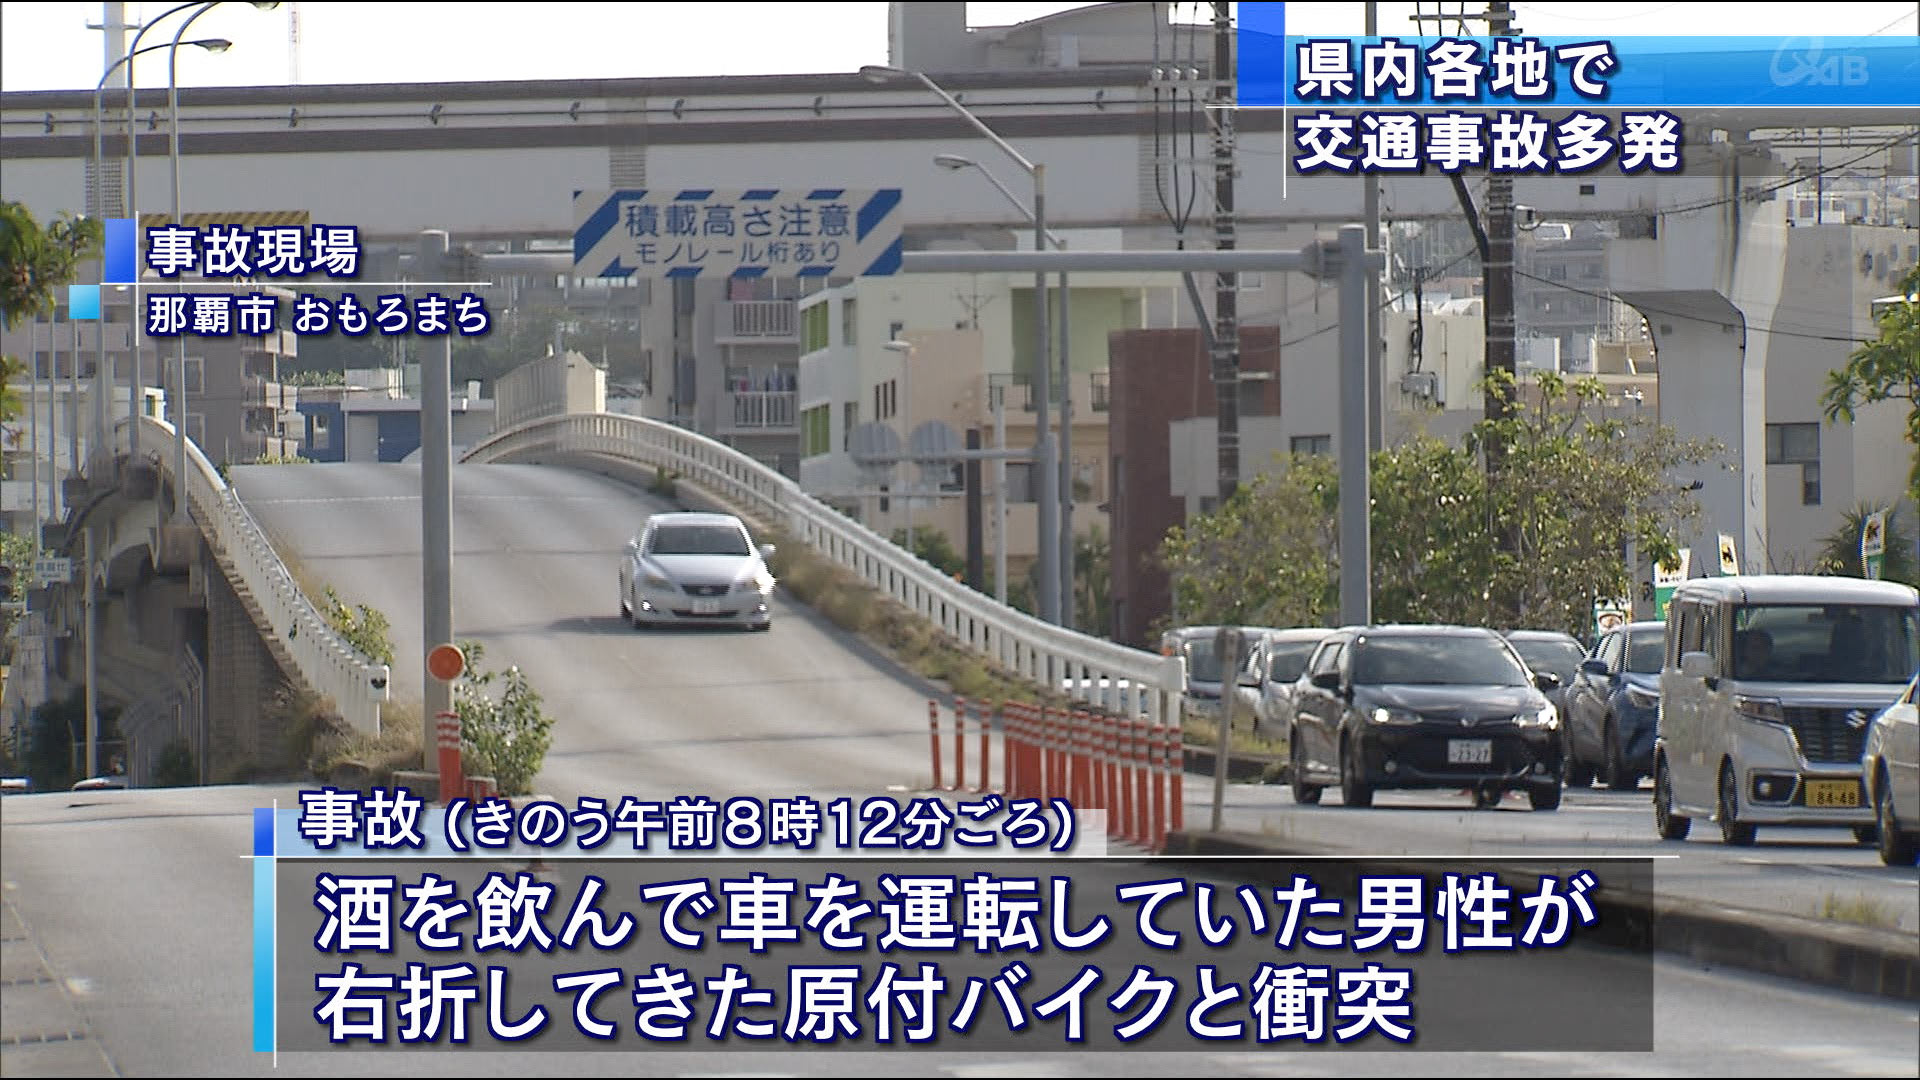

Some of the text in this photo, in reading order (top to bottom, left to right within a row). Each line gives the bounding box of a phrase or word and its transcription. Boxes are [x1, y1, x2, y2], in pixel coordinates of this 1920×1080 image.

[624, 203, 850, 238] 積載高さ注意
[635, 240, 842, 265] モノレール桁あり
